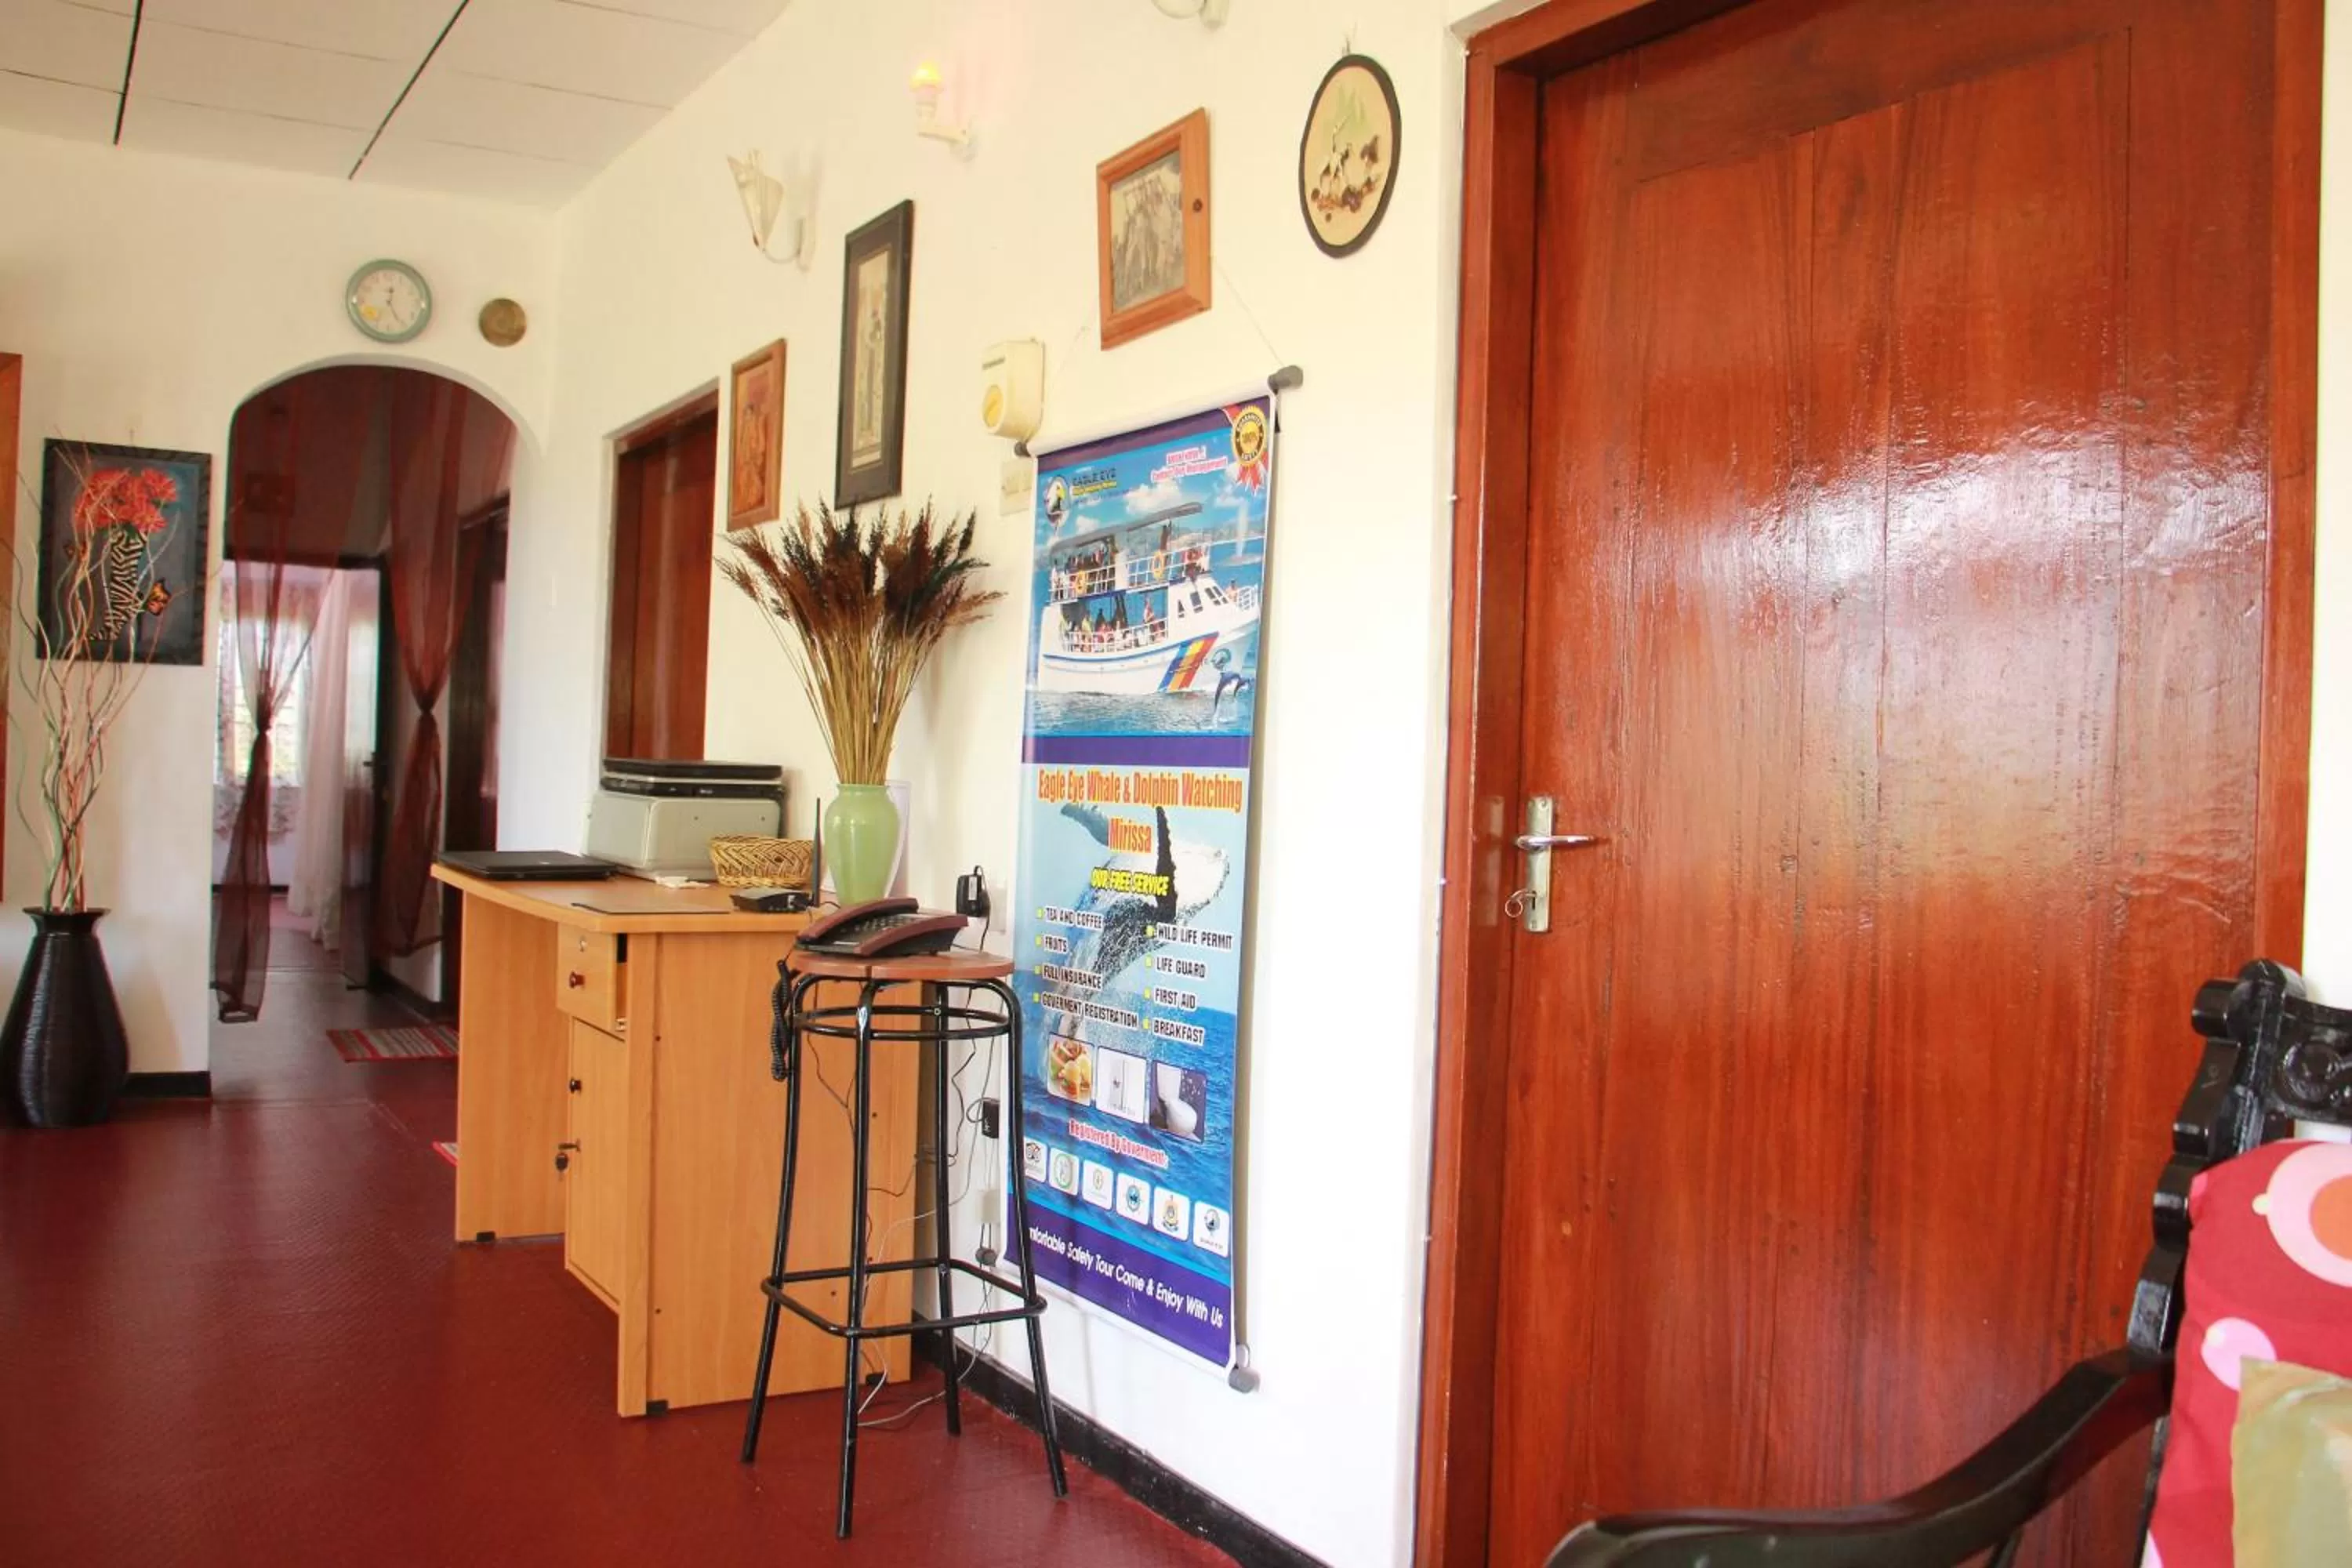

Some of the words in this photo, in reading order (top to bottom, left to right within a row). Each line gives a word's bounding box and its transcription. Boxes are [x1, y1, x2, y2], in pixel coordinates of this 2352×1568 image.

[1038, 768, 1065, 803] Eagle
[1068, 770, 1084, 804] Eye
[1087, 770, 1120, 802] Whale
[1123, 779, 1131, 801] &
[1134, 772, 1179, 808] Dolphin
[1182, 772, 1243, 815] Watching
[1109, 818, 1152, 853] Mirissa
[1109, 869, 1132, 892] FREE
[1134, 872, 1169, 896] SERVICE
[1046, 908, 1058, 922] TEA
[1060, 909, 1073, 924] AND
[1076, 912, 1102, 928] COFFEE
[1044, 935, 1067, 953] FRUITS
[1157, 927, 1177, 943] WILD
[1180, 929, 1197, 945] LIFE
[1201, 931, 1232, 949] PERMIT
[1044, 965, 1058, 981] FULL
[1061, 969, 1102, 989] INSURANCE
[1156, 956, 1174, 973] LIFE
[1176, 960, 1206, 978] GUARD
[1155, 988, 1177, 1005] FIRST
[1181, 993, 1196, 1009] AID
[1154, 1019, 1203, 1044] BREAKFAST
[1067, 1242, 1094, 1271] Safety
[1094, 1254, 1114, 1278] Tour
[1116, 1265, 1144, 1292] Come
[1146, 1278, 1155, 1296] &
[1156, 1282, 1185, 1313] Enjoy
[1186, 1295, 1208, 1322] With
[1210, 1305, 1223, 1328] Us
